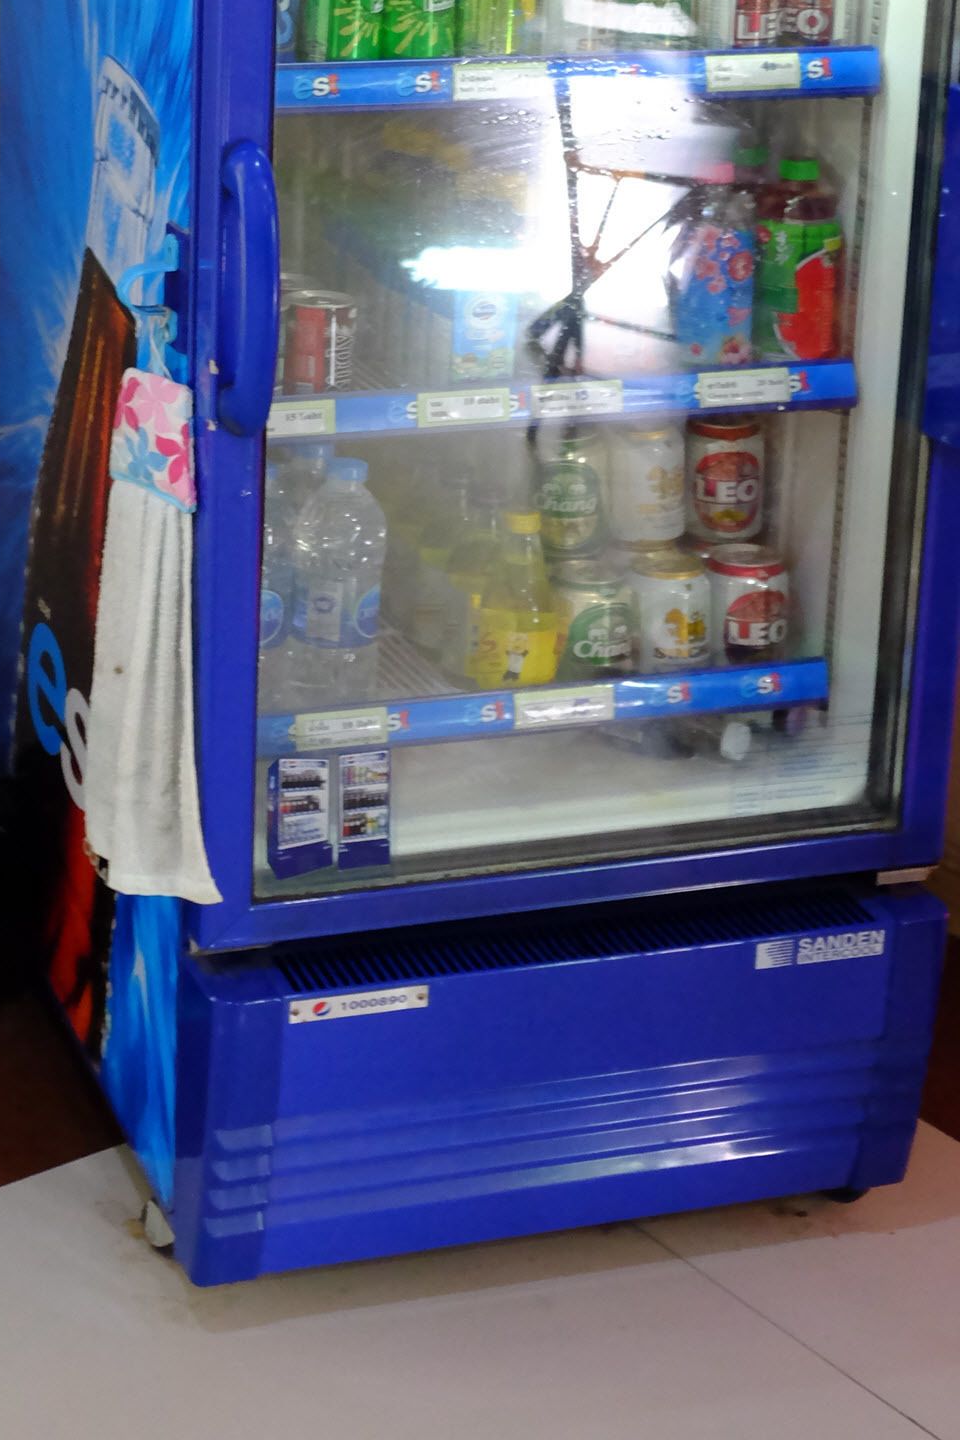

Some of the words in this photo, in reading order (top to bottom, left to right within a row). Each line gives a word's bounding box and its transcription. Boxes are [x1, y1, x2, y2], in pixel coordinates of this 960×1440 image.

[293, 73, 340, 100] est
[397, 71, 441, 97] est
[696, 478, 758, 503] LEO
[729, 618, 786, 646] LEO
[799, 930, 885, 953] SANDEN
